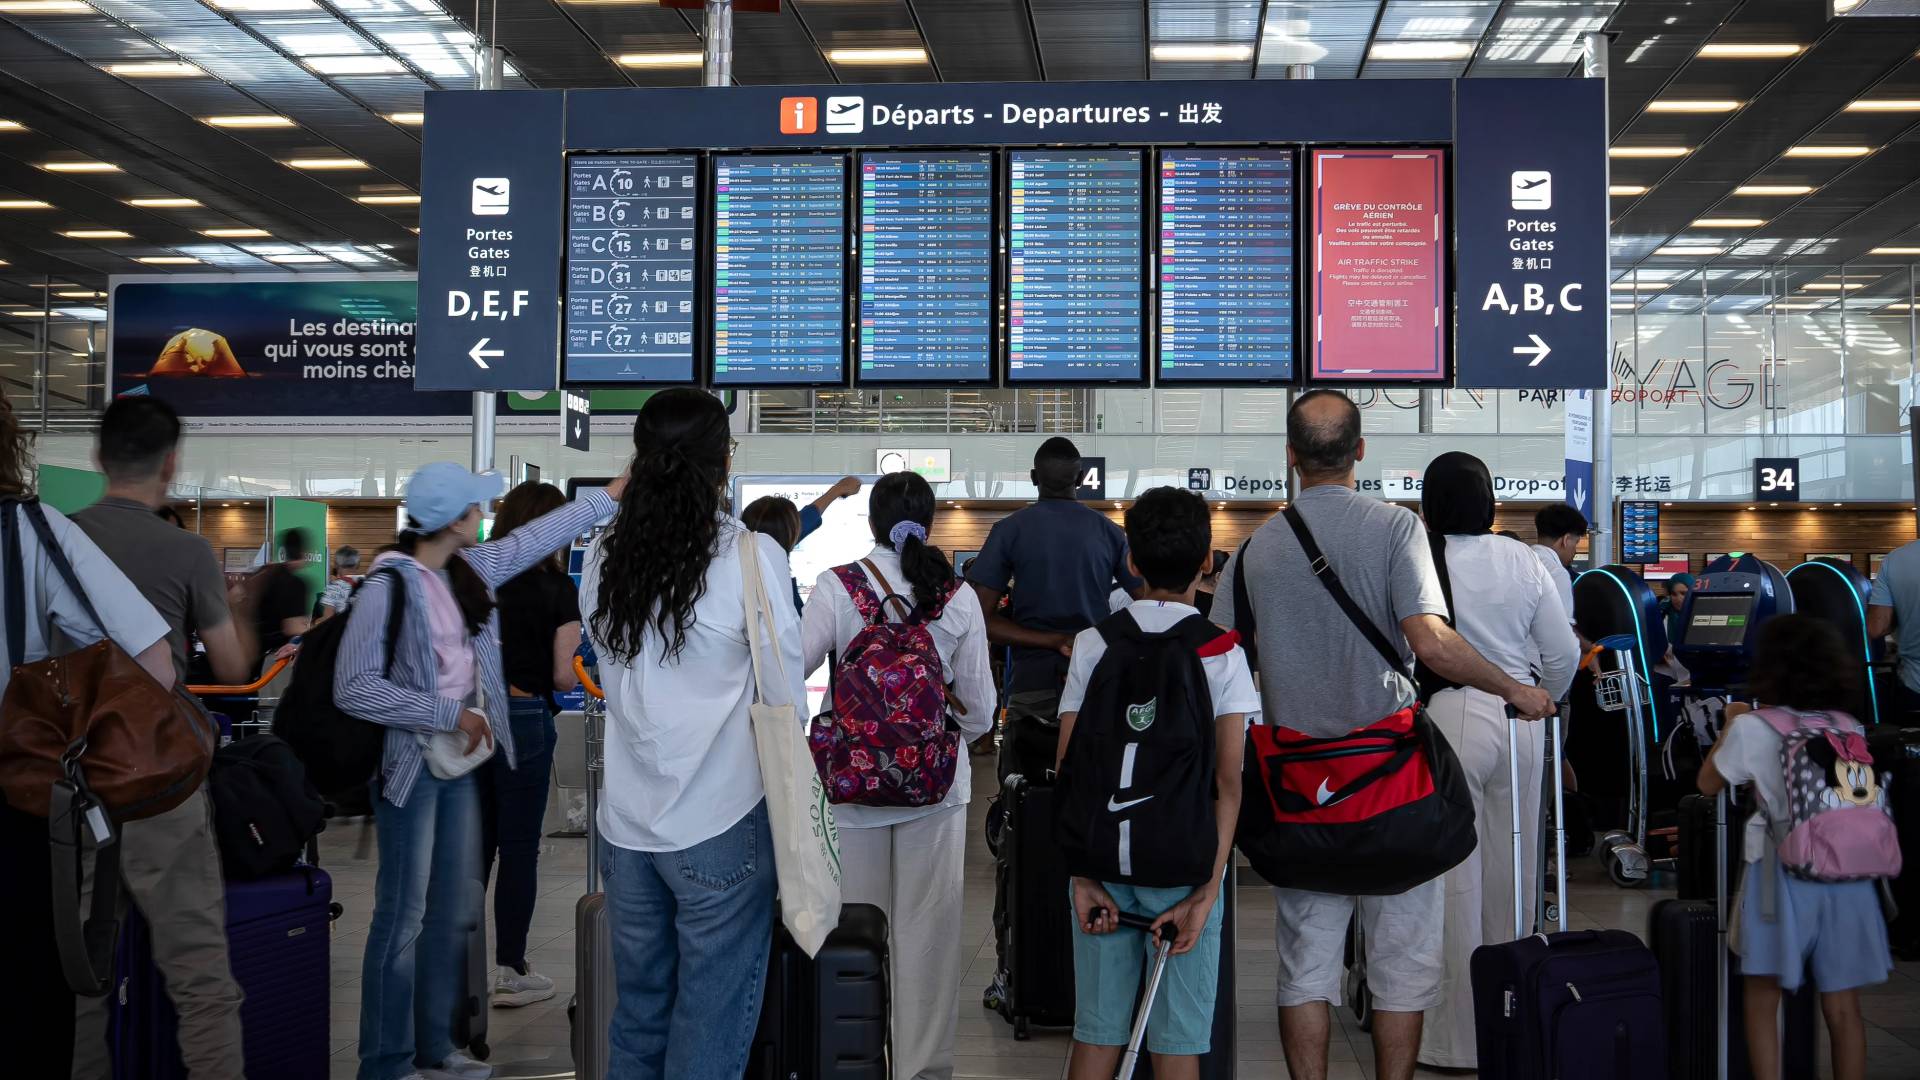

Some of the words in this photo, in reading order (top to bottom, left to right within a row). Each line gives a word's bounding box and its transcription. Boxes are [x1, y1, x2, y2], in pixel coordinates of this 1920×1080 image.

[872, 104, 975, 127] Départs
[1003, 103, 1151, 127] Departures
[1178, 102, 1223, 124] 出发
[592, 175, 608, 191] A
[618, 178, 633, 189] 10
[593, 206, 606, 222] B
[616, 210, 625, 221] 9
[1333, 202, 1362, 211] GRÈVE
[1363, 203, 1376, 211] DU
[1377, 202, 1423, 211] CONTRÔLE
[1362, 211, 1394, 219] AÉRIEN
[1507, 219, 1557, 232] Portes
[466, 229, 513, 241] Portes
[592, 237, 605, 253] C
[616, 241, 631, 252] 15
[1510, 238, 1554, 251] Gates
[469, 247, 510, 259] Gates
[469, 265, 507, 278] 登机口
[1511, 257, 1552, 270] 登机口
[591, 268, 605, 284] D
[615, 272, 631, 283] 31
[448, 290, 529, 321] D,E,F
[591, 299, 604, 315] E
[615, 303, 632, 315] 27
[1482, 283, 1582, 315] A,B,C
[290, 318, 327, 337] Les
[591, 330, 603, 346] F
[614, 334, 632, 345] 27
[264, 339, 297, 363] qui
[303, 342, 354, 358] vous
[359, 340, 408, 358] sont
[303, 361, 368, 379] moins
[1518, 389, 1566, 402] PARI
[1075, 467, 1101, 490] 4
[1224, 475, 1289, 494] Dépos
[1614, 475, 1672, 492] 李托运
[1760, 468, 1795, 492] 34
[794, 492, 799, 500] 3
